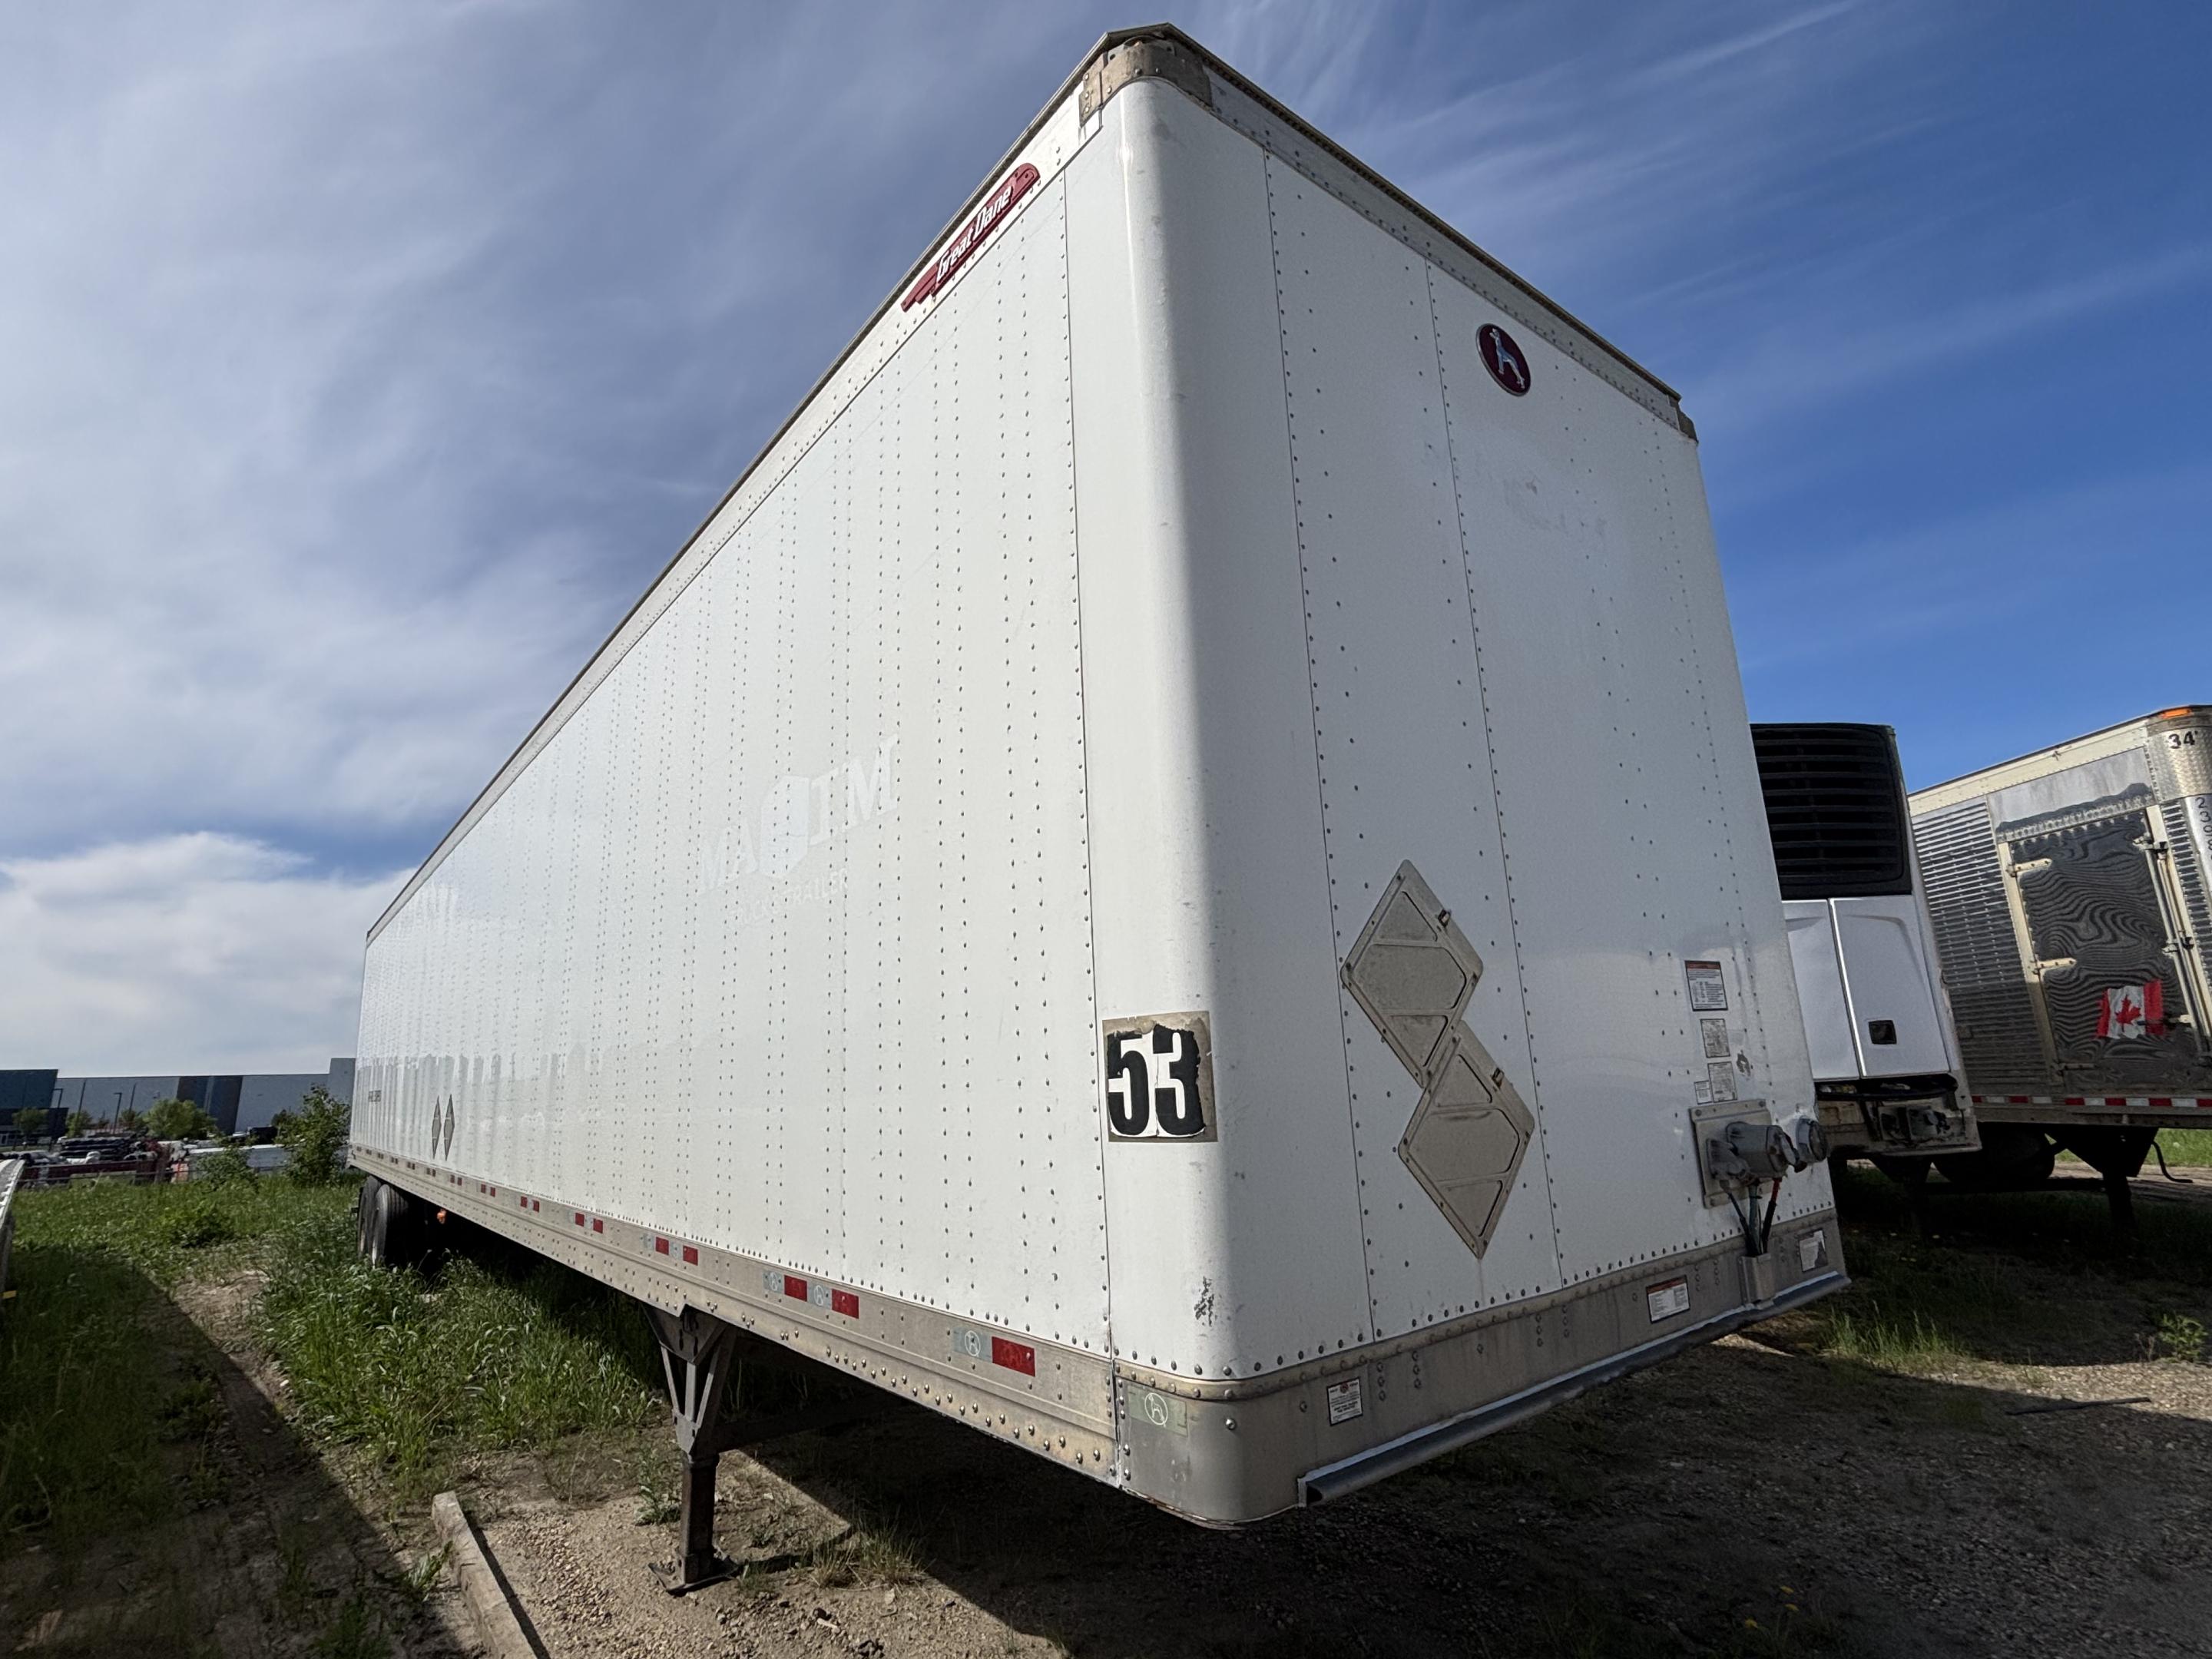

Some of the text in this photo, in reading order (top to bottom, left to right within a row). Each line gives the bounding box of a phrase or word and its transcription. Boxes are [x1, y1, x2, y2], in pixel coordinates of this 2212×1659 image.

[935, 185, 1013, 284] Great Dane
[1107, 1024, 1207, 1137] 53
